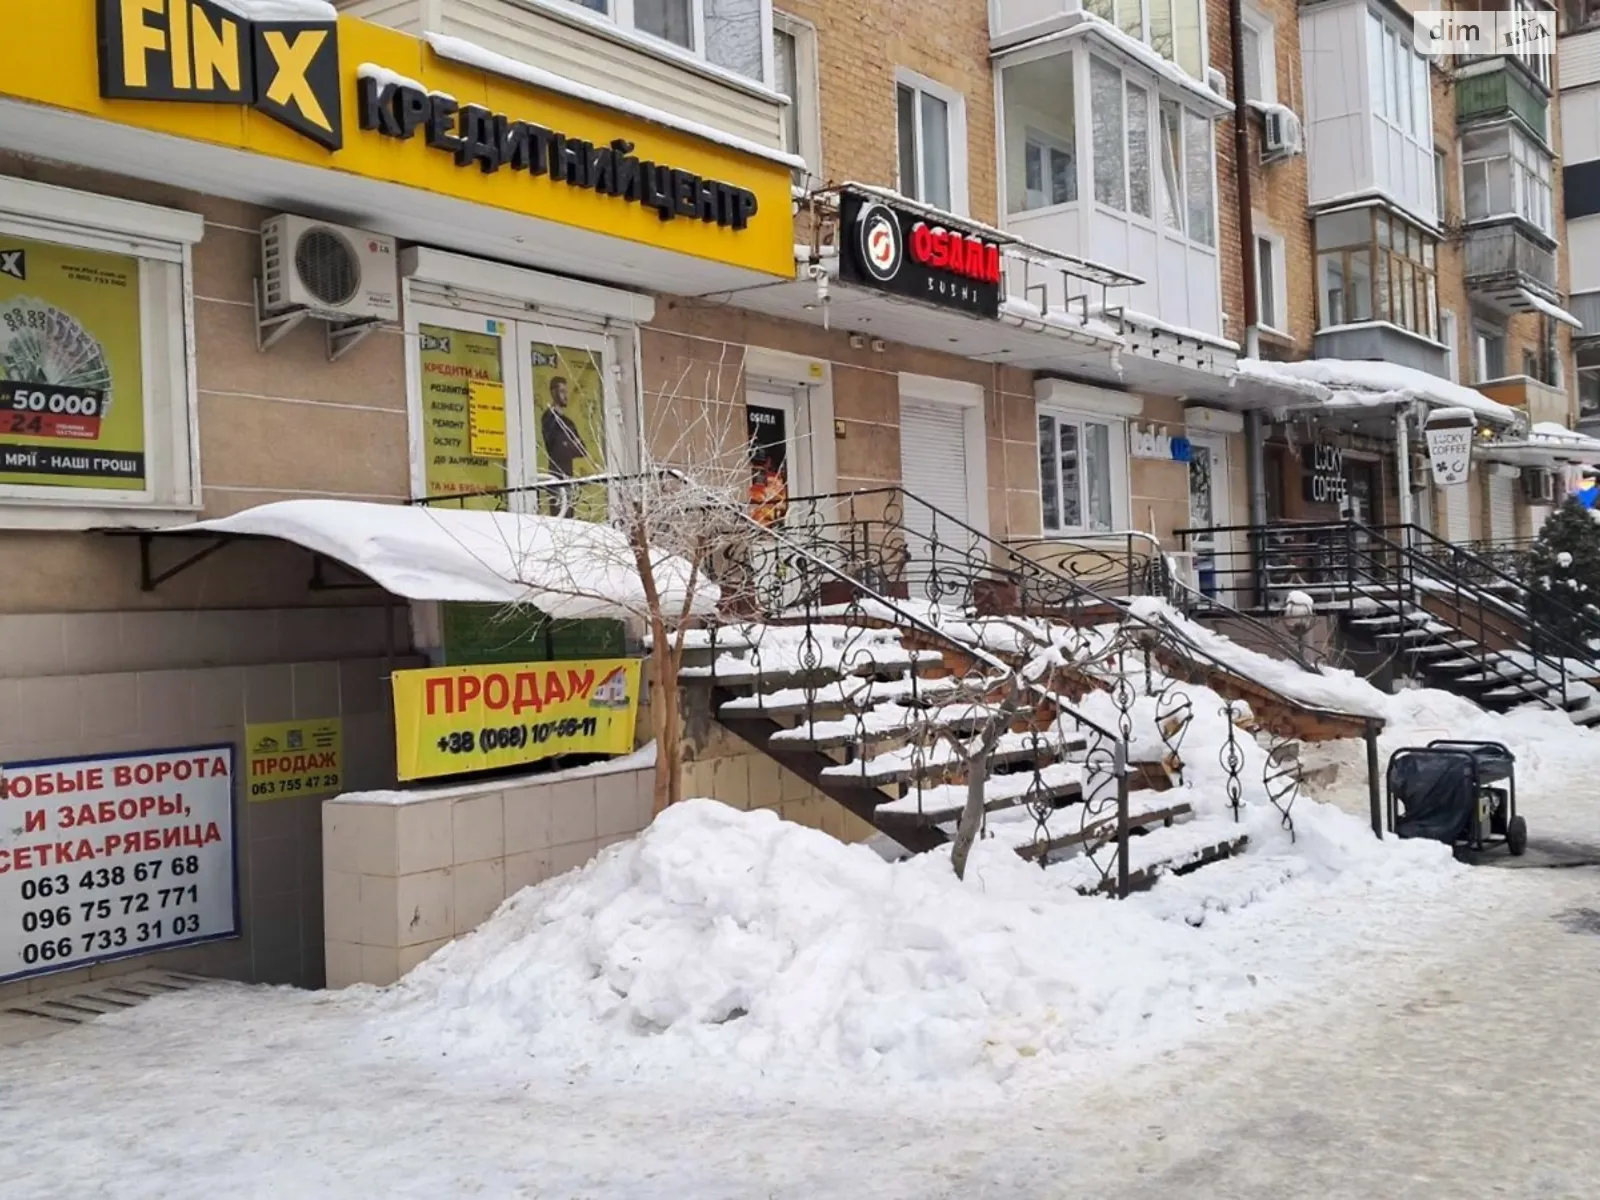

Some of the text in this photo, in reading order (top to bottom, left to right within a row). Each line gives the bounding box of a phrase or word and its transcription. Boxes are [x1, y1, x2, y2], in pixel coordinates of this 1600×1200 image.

[357, 76, 758, 231] КРЕДИТНИЙ ЦЕНТР
[911, 223, 1000, 283] OSAMA
[928, 277, 978, 303] SUSHI
[424, 362, 472, 378] КРЕДИТИ
[12, 389, 46, 411] 50
[48, 393, 97, 417] 000
[430, 383, 468, 395] РОЗВИТО
[10, 413, 43, 434] 24
[432, 418, 465, 430] РЕМОНТ
[5, 451, 38, 468] МРІЇ
[51, 455, 90, 470] НАШІ
[94, 457, 137, 472] ГРОШІ
[1314, 443, 1342, 476] LUCKY
[1432, 444, 1468, 456] COFFEE
[1313, 475, 1347, 502] COFFEE
[426, 668, 595, 716] ПРОДАМ
[437, 730, 475, 755] +38
[479, 723, 528, 754] (068)
[113, 756, 228, 788] ВОРОТА
[252, 752, 337, 776] ПРОДАЖ
[252, 774, 339, 796] 063 755 47 29
[25, 793, 191, 833] И ЗАБОРЫ,
[0, 821, 222, 875] СЕТКА-РЯБИЦА
[20, 855, 199, 901] 063 438 67 68
[22, 884, 198, 933] 096 75 72 771
[22, 913, 200, 965] 066 733 31 03
